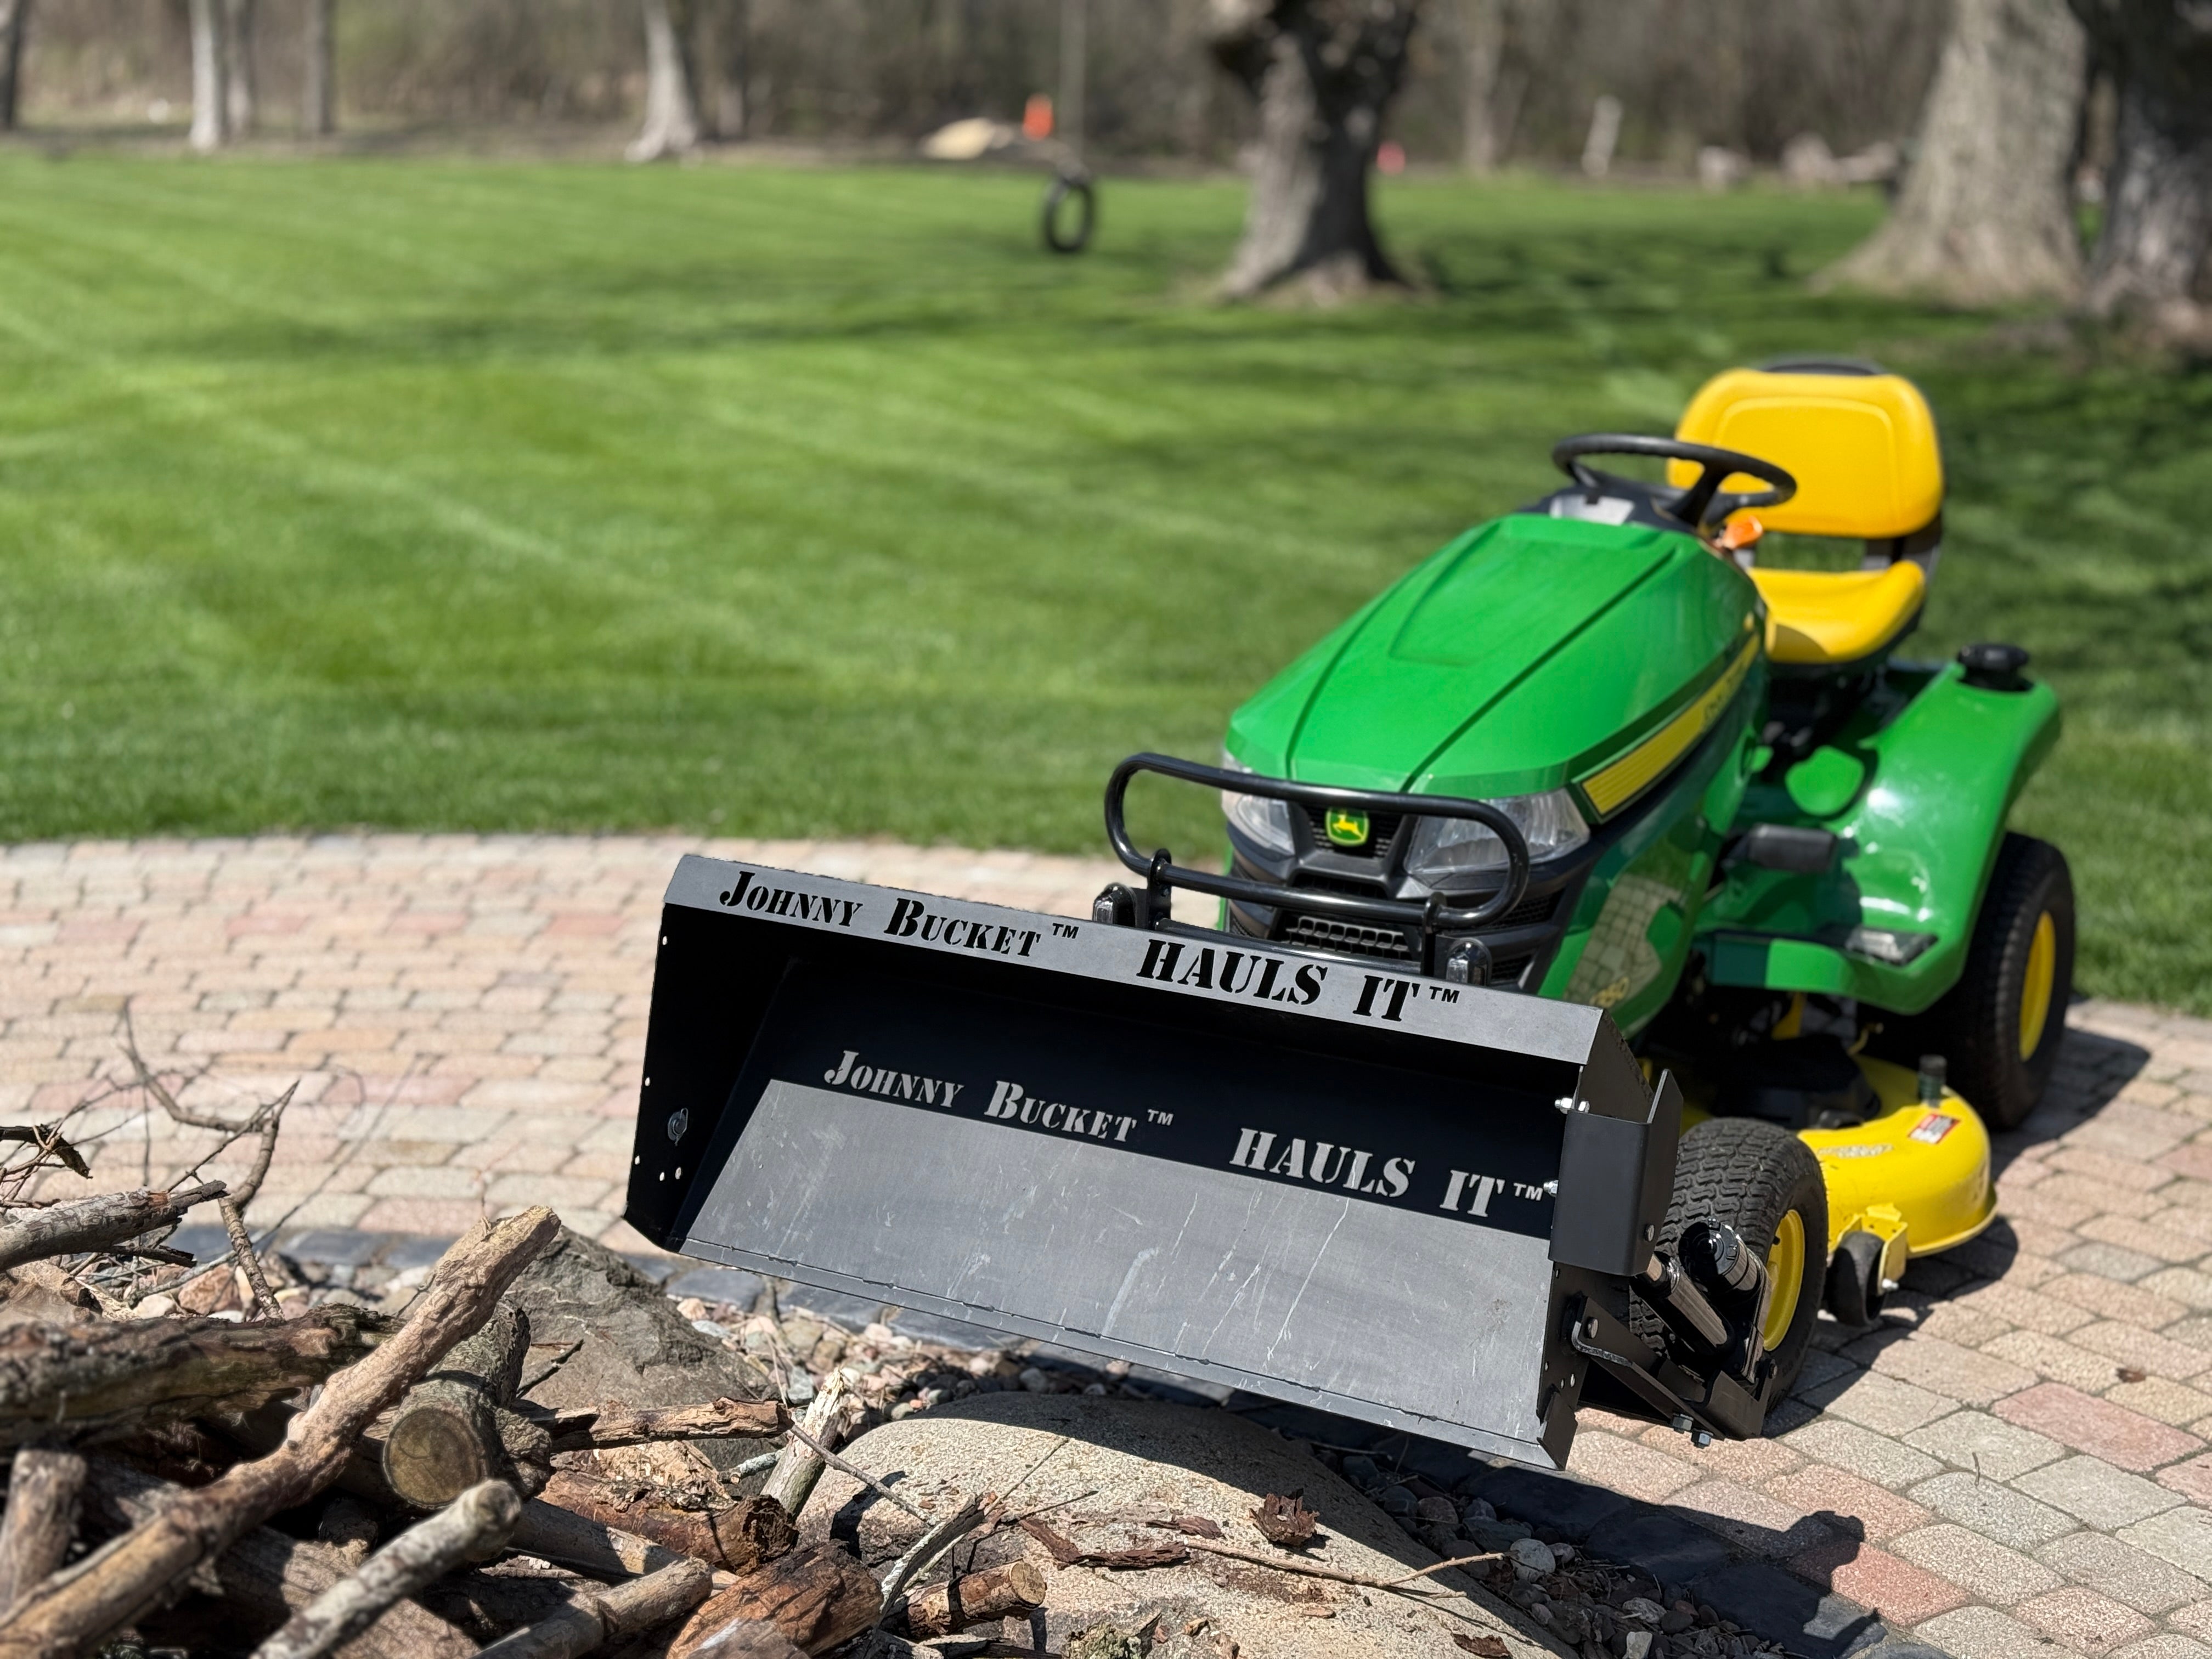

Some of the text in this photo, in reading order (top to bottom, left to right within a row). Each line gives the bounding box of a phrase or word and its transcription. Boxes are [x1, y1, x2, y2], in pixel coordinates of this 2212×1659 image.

[719, 871, 863, 928] JOHNNY
[1136, 939, 1328, 1005] HAULS
[823, 1050, 965, 1108] JOHNNY
[1229, 1127, 1415, 1197] HAULS
